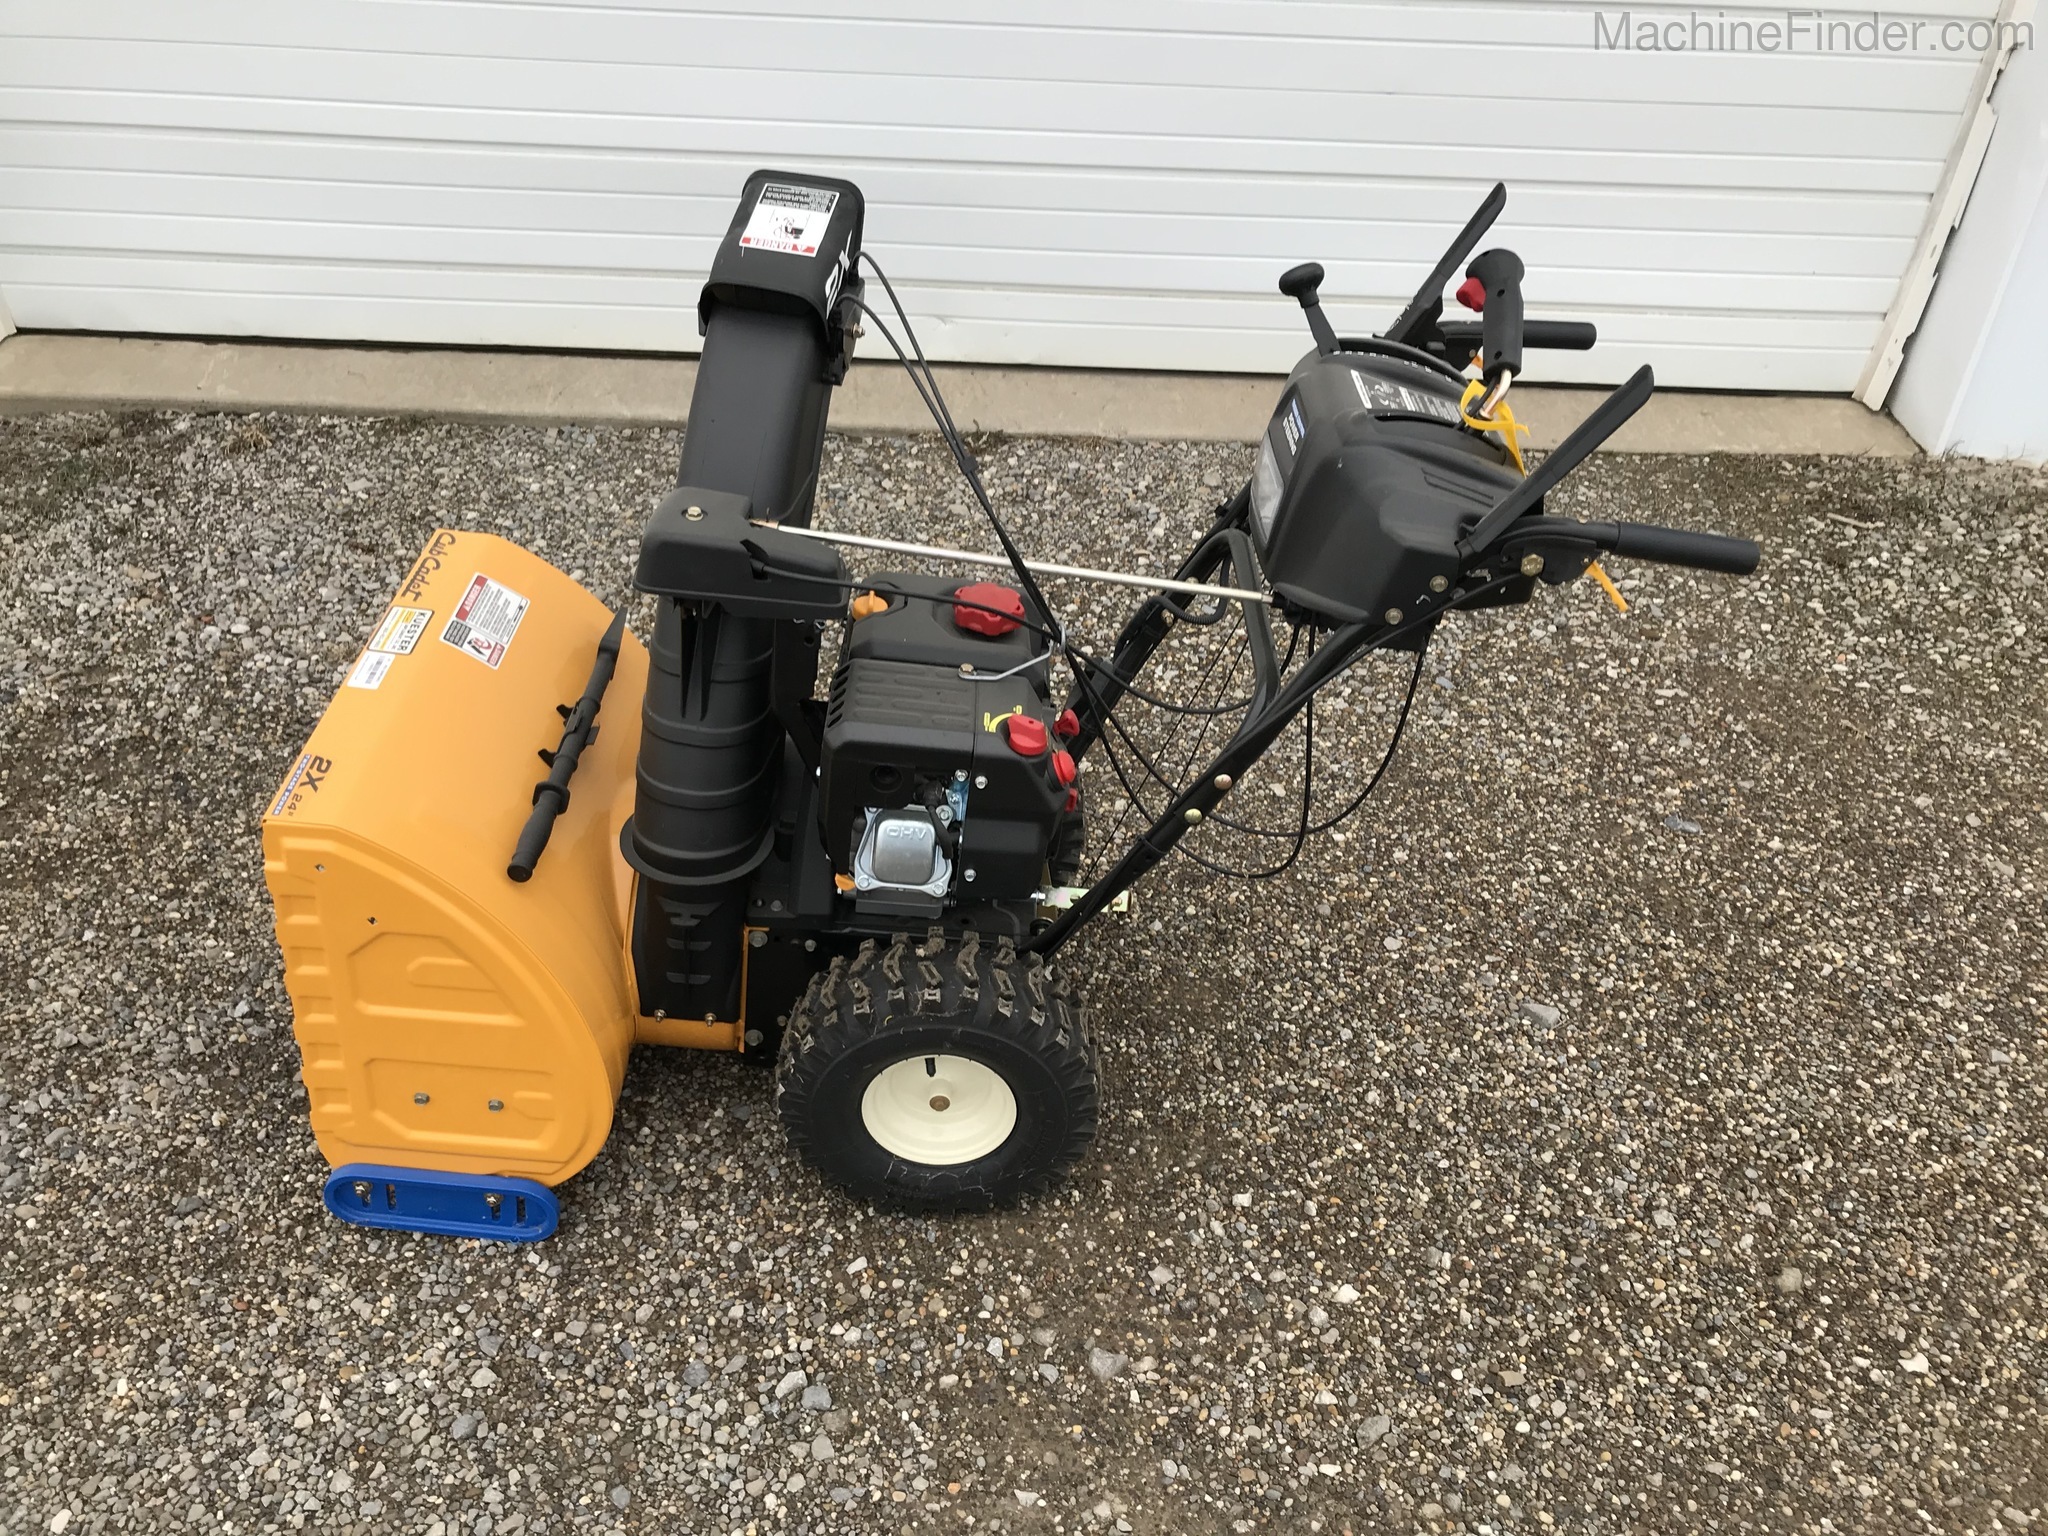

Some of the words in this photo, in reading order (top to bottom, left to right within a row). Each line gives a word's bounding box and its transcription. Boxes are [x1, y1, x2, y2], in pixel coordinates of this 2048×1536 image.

[428, 532, 457, 556] Cub
[401, 556, 442, 602] Cadet
[396, 611, 428, 651] KUESTER
[298, 755, 332, 793] 2X
[287, 793, 303, 817] 24"
[886, 826, 926, 840] OHV
